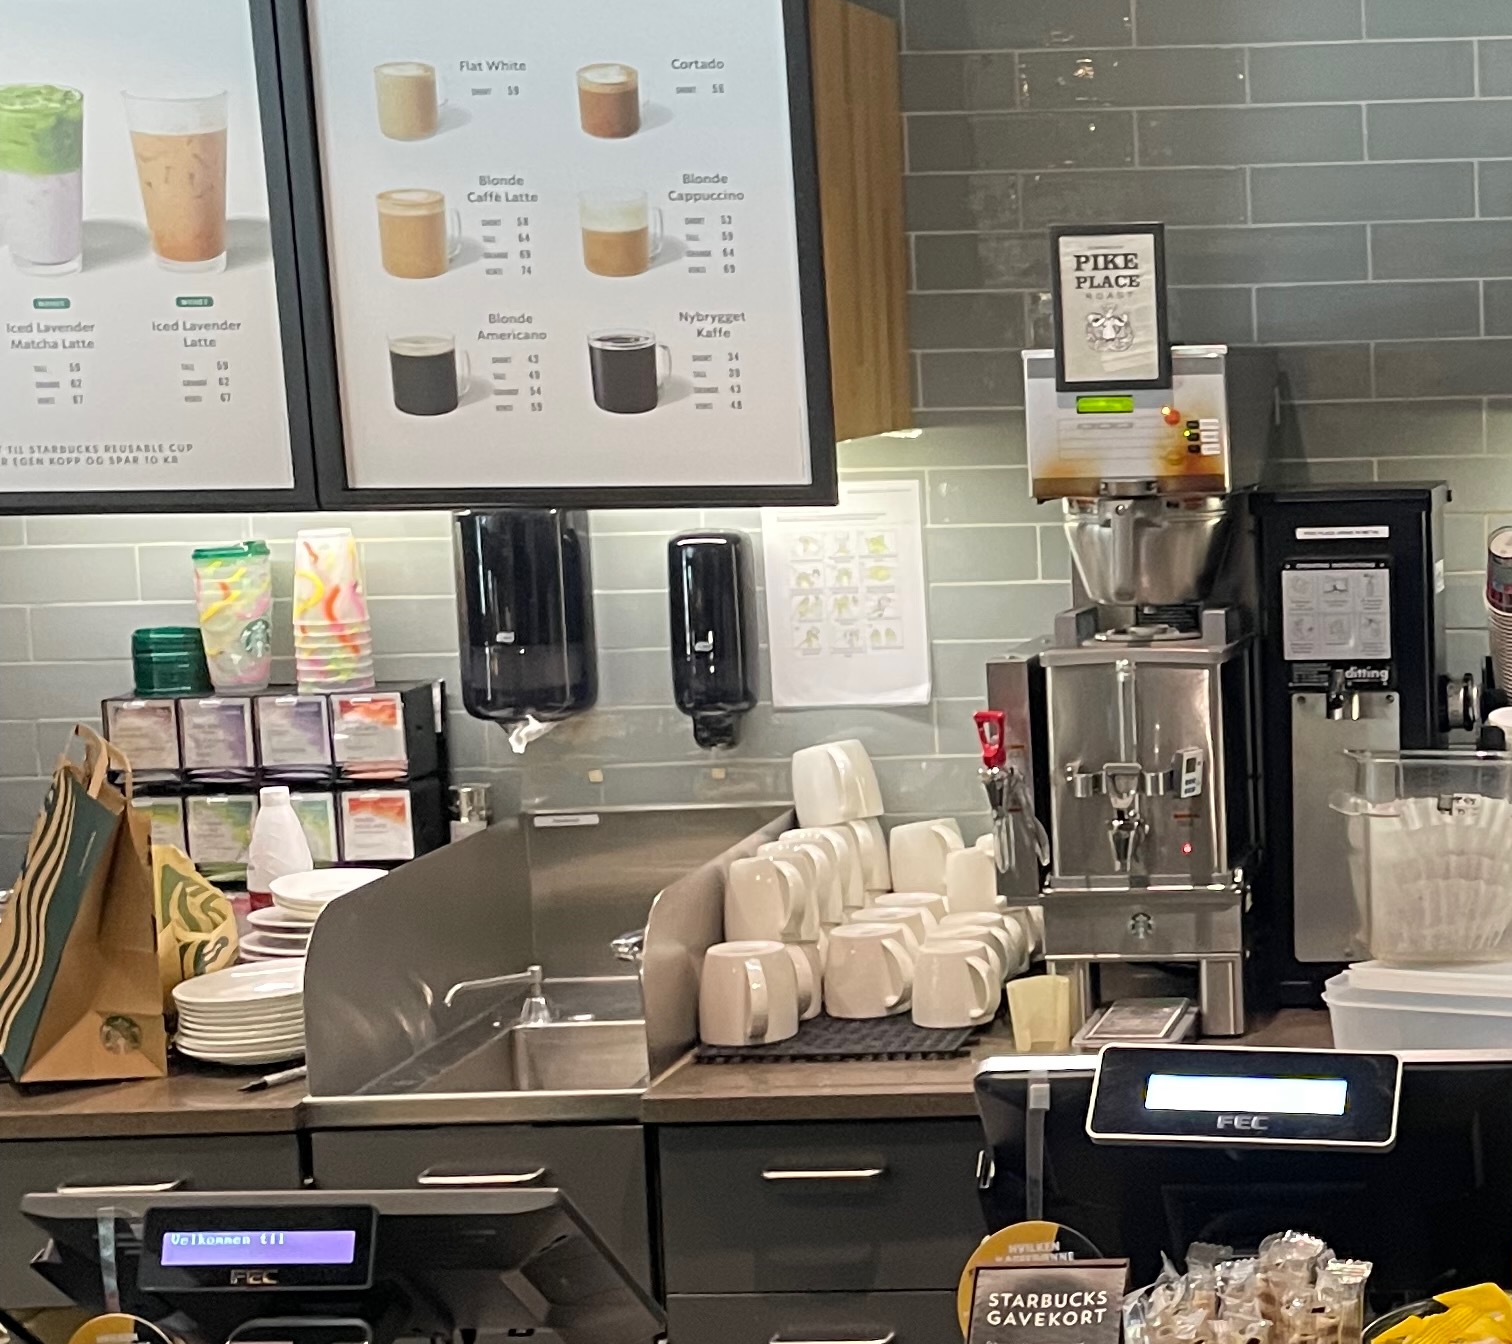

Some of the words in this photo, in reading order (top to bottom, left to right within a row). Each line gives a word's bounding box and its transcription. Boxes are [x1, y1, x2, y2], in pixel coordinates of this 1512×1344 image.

[459, 61, 483, 72] Flat
[485, 60, 526, 72] White
[671, 59, 724, 70] Cortado
[479, 175, 524, 187] Blonde
[682, 173, 728, 185] Blonde
[505, 191, 538, 202] Latte
[668, 190, 744, 203] Cappuccino
[1073, 253, 1139, 271] PIKE
[1075, 275, 1140, 289] PLACE
[489, 314, 533, 324] Blonde
[679, 312, 746, 324] Nybrygget
[7, 323, 33, 333] Iced
[37, 323, 95, 332] Lavender
[152, 322, 179, 331] Iced
[183, 321, 241, 331] Lavender
[478, 330, 547, 340] Americano
[697, 328, 731, 338] Kaffe
[11, 339, 58, 350] Matcha
[62, 339, 94, 349] Latte
[184, 338, 216, 347] Latte
[1345, 666, 1388, 681] ditting
[1217, 1114, 1268, 1130] FEC
[230, 1270, 279, 1284] FEC
[989, 1291, 1107, 1308] STARBUCKS
[986, 1308, 1107, 1327] GAVEKORT
